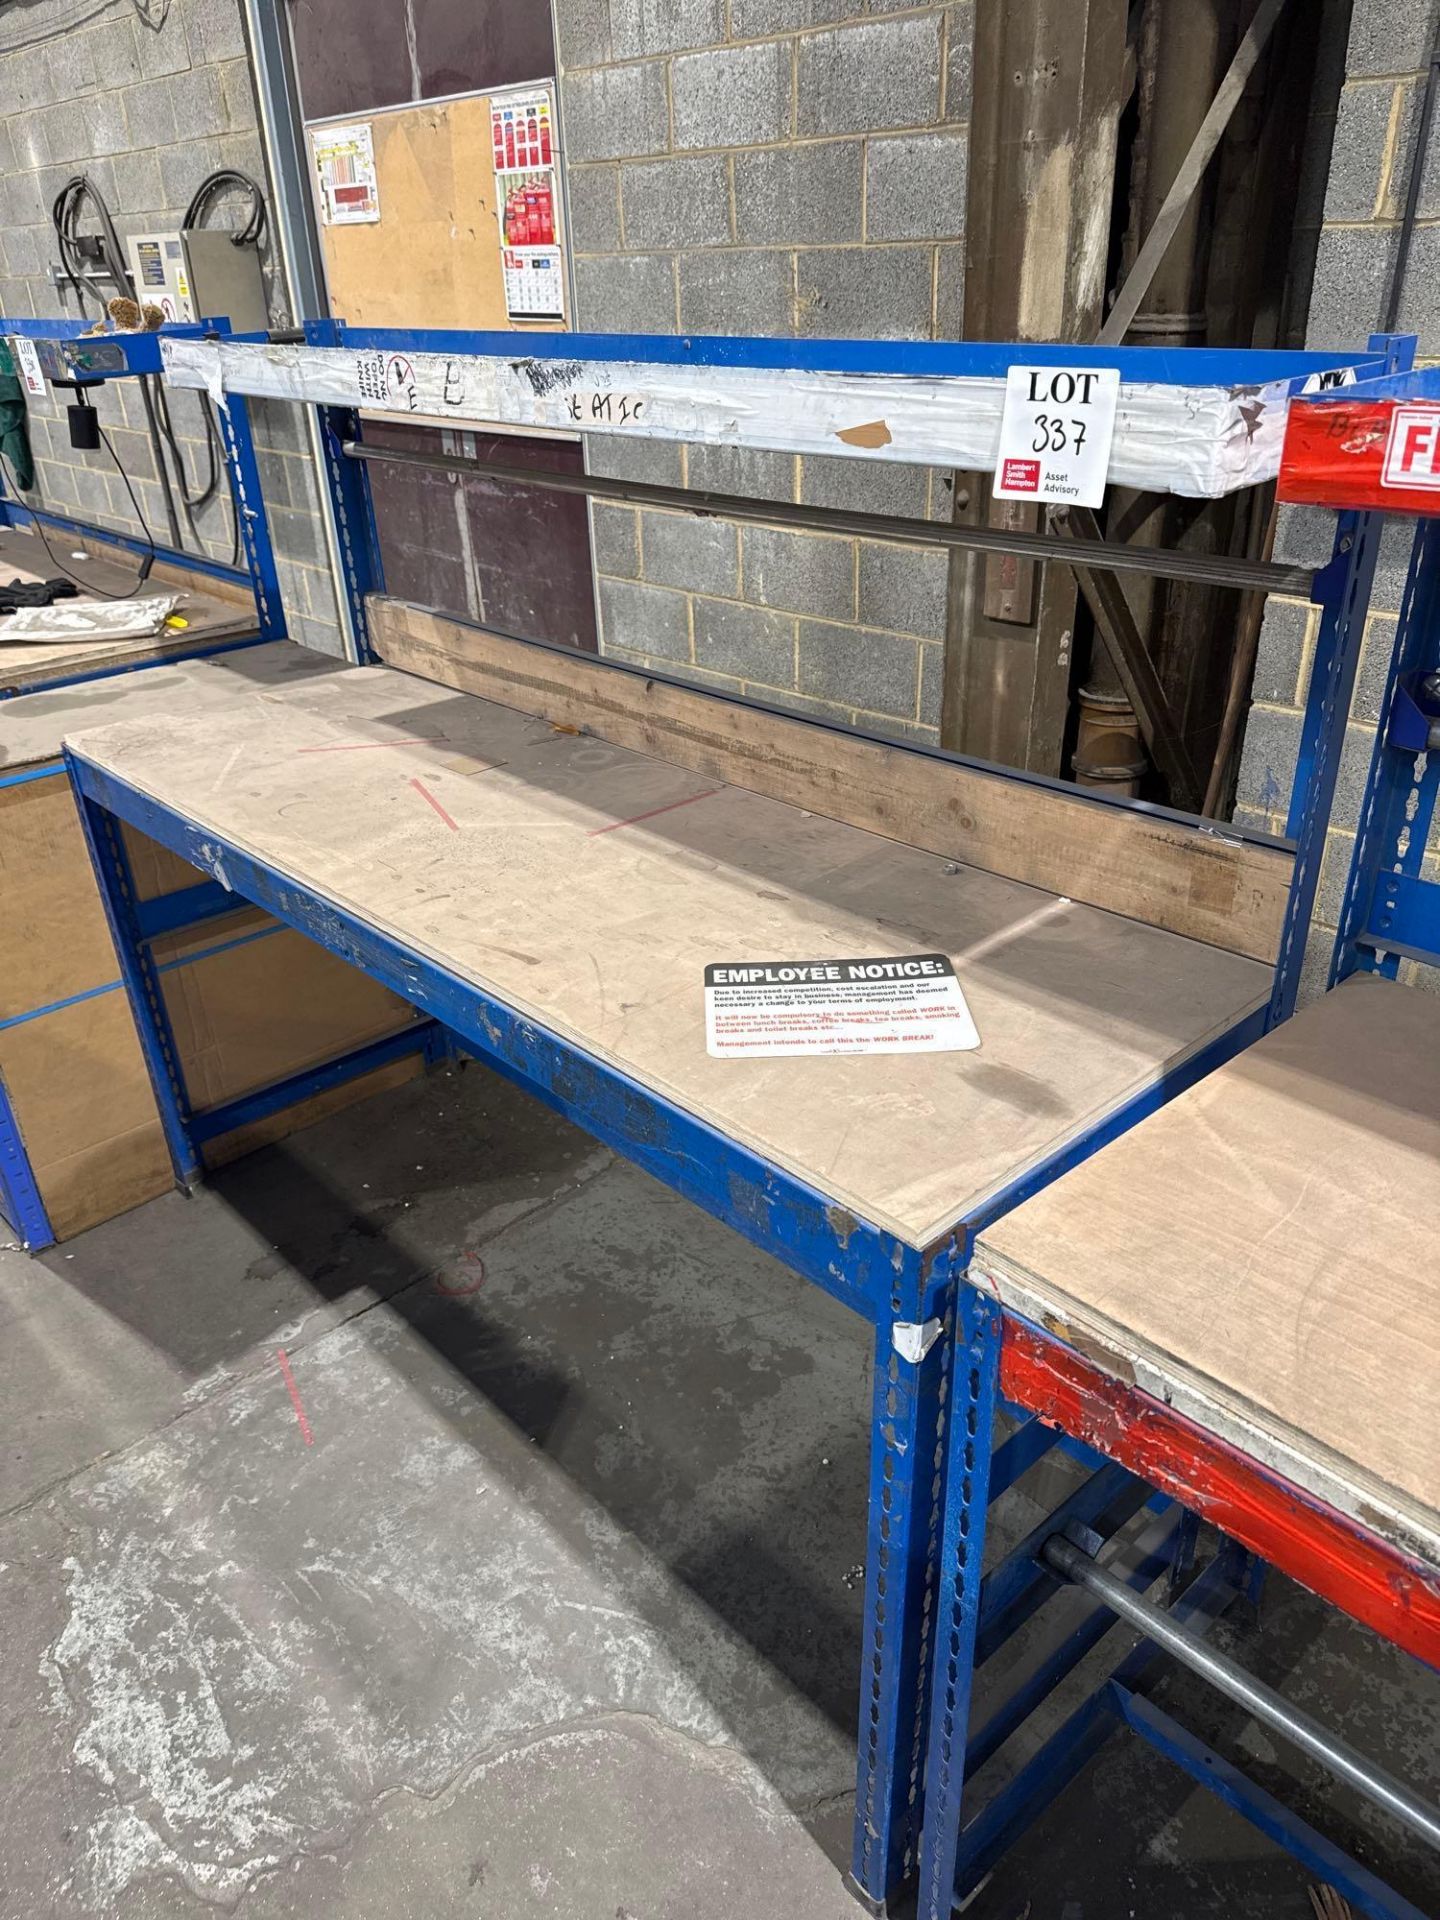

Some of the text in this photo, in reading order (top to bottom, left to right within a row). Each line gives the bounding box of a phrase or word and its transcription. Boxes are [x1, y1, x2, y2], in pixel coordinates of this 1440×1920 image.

[1027, 372, 1099, 404] LOT
[1032, 414, 1086, 456] 337
[1007, 462, 1036, 471] Lambert
[1006, 470, 1026, 478] Smith
[1045, 472, 1068, 482] Asset
[1044, 484, 1080, 496] Advisory
[713, 960, 945, 983] EMPLOYEE NOTICE:
[866, 996, 918, 1004] employment.
